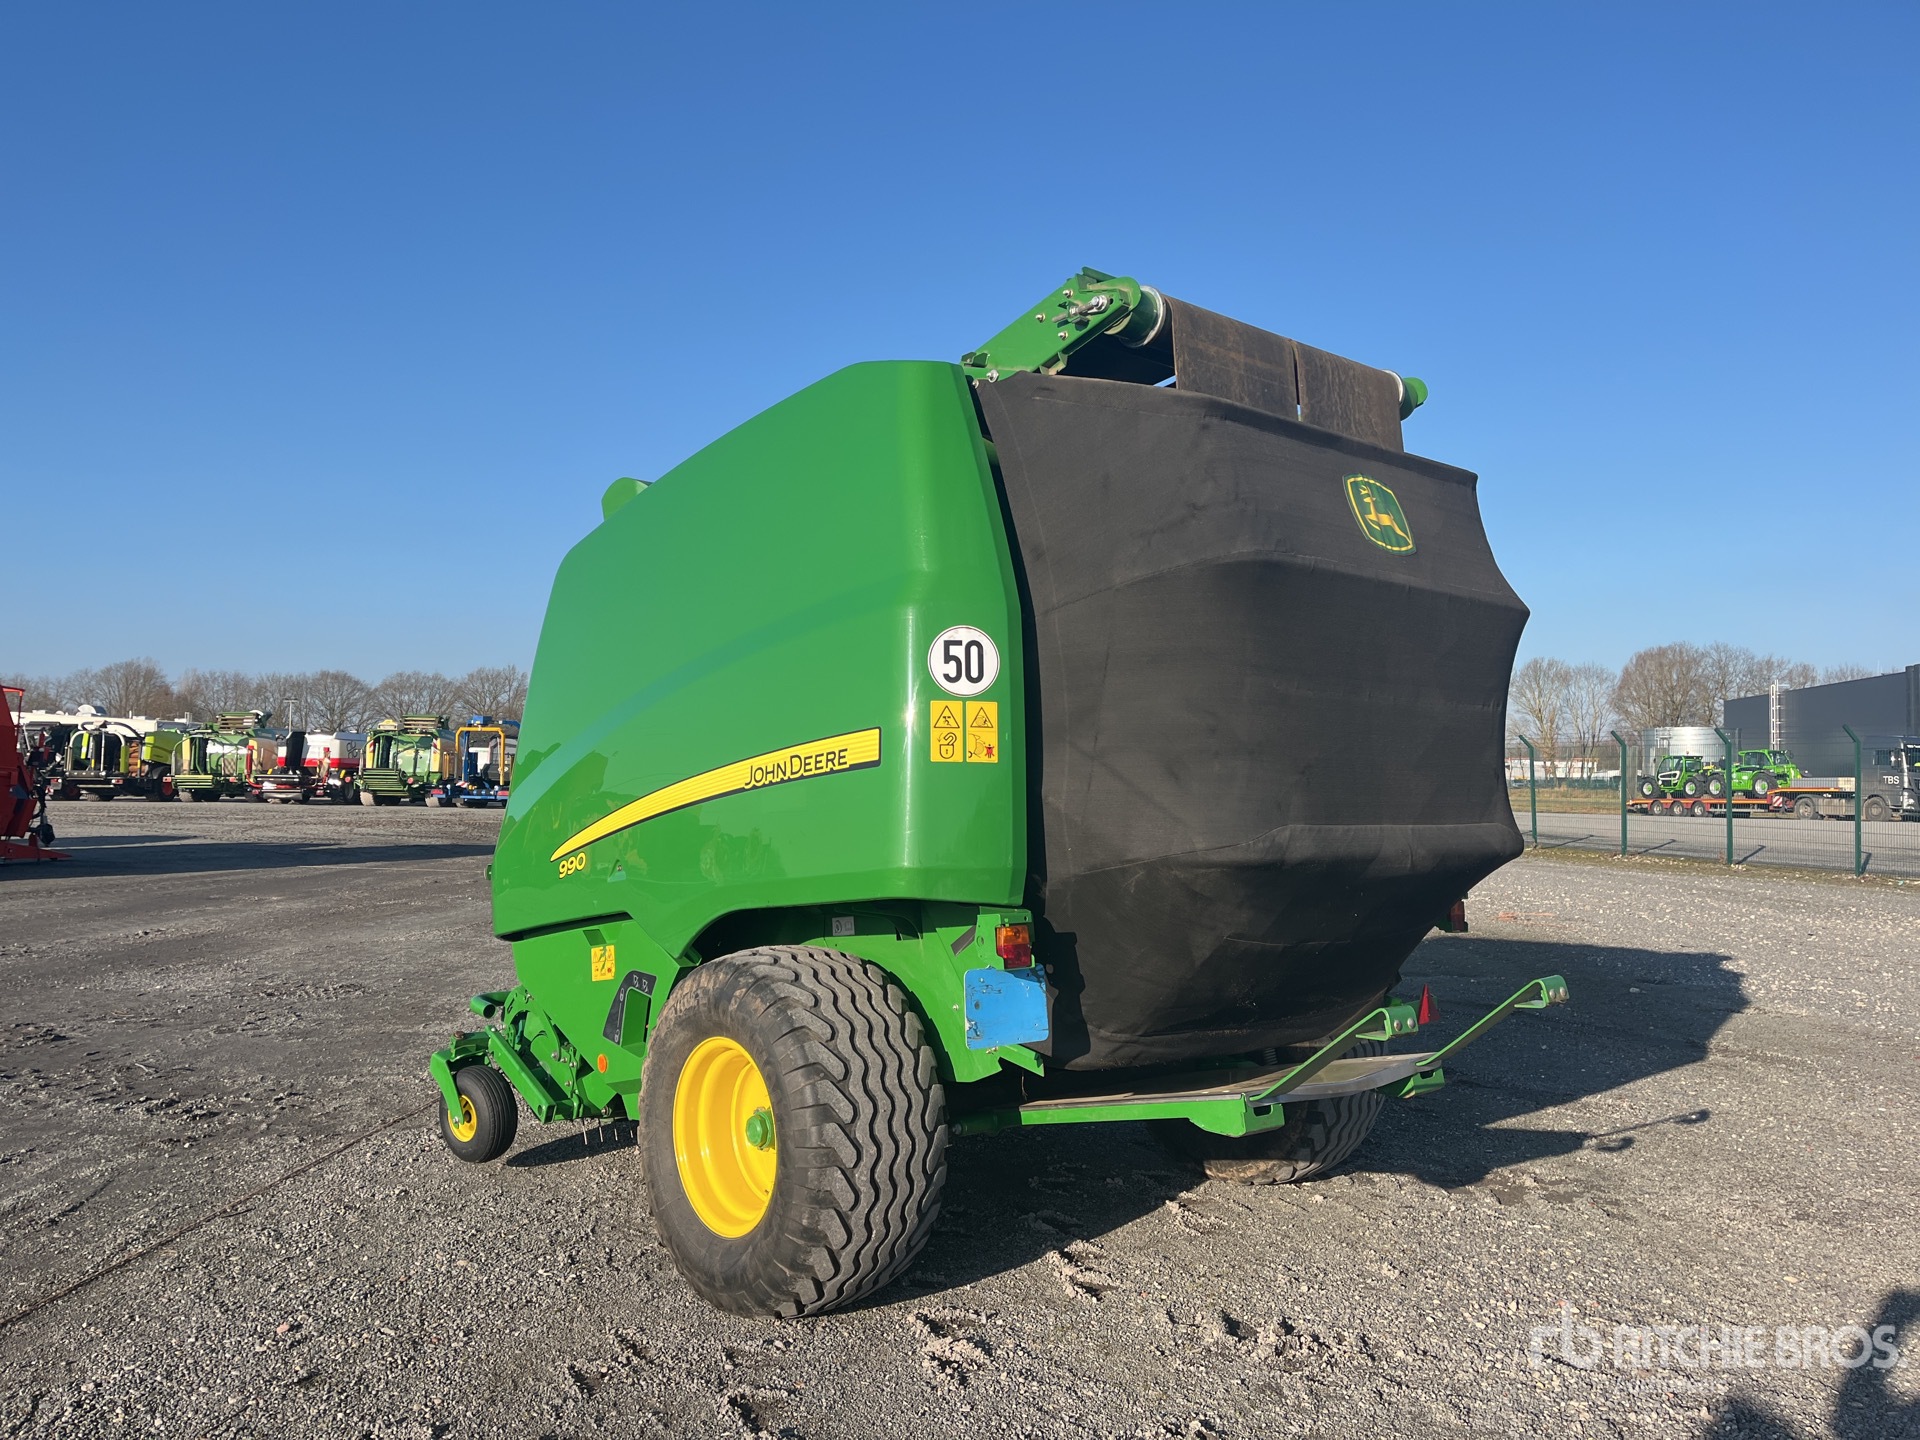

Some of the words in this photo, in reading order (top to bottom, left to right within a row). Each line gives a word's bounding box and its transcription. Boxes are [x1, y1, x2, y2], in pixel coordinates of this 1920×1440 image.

[943, 640, 984, 684] 50
[746, 760, 787, 787] JOHN
[790, 748, 848, 776] DEERE
[1883, 776, 1900, 785] TBS
[558, 852, 586, 879] 990
